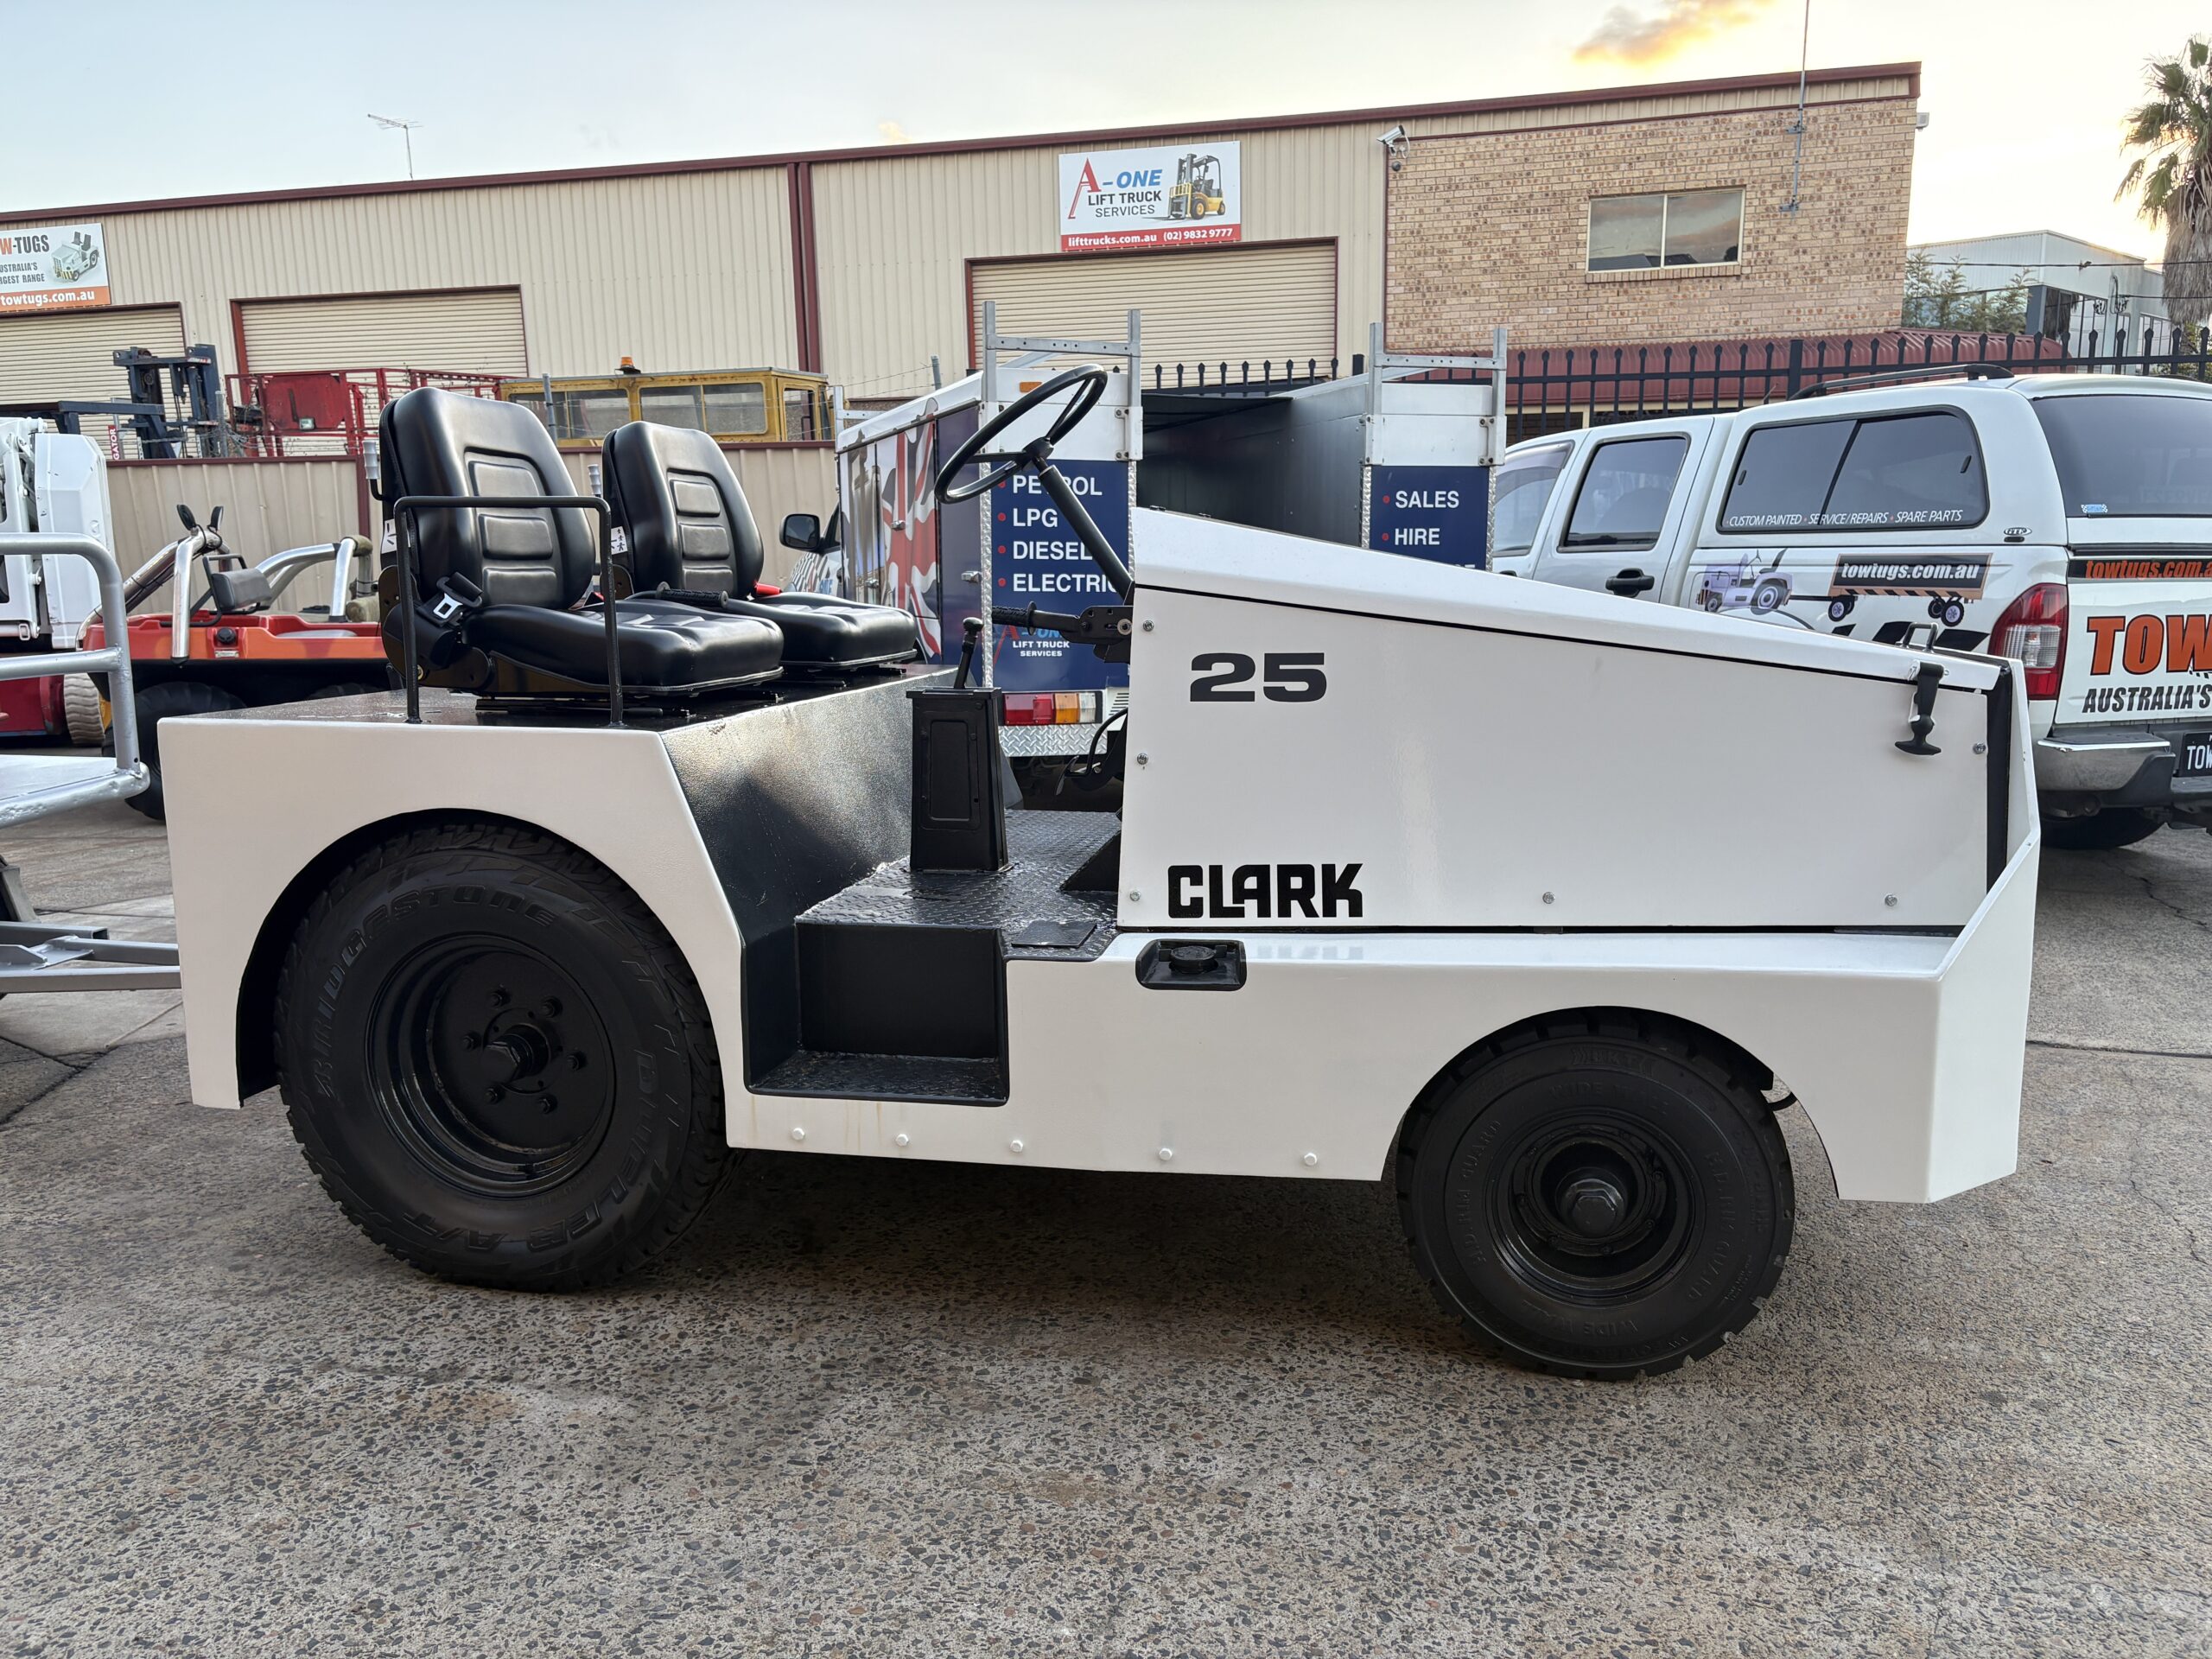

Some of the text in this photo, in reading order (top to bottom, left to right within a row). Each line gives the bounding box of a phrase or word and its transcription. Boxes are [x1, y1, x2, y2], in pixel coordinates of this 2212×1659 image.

[1068, 157, 1163, 219] A-ONE
[1088, 190, 1162, 207] LIFT TRUCK
[1095, 205, 1155, 218] SERVICES
[1068, 228, 1233, 247] lifttrucks.com.au (02) 9832 9777
[22, 273, 45, 283] RANGE
[0, 290, 95, 307] towtugs.com.au
[109, 428, 120, 460] GATOR
[1013, 475, 1103, 496] PEOL
[1395, 490, 1459, 508] SALES
[1013, 508, 1058, 528] LPG
[1729, 509, 1963, 527] CUSTOM PAINTED SERVICE/REPAIRS SPARE PARTS
[1395, 528, 1440, 545] HIRE
[1013, 541, 1093, 561] DIESEL
[1840, 563, 1980, 581] towtugs.com.au
[1190, 652, 1327, 702] 25
[2082, 683, 2212, 713] AUSTRALIA'S
[1168, 863, 1363, 918] CLARK
[313, 883, 560, 1101] BRIDGESTONE
